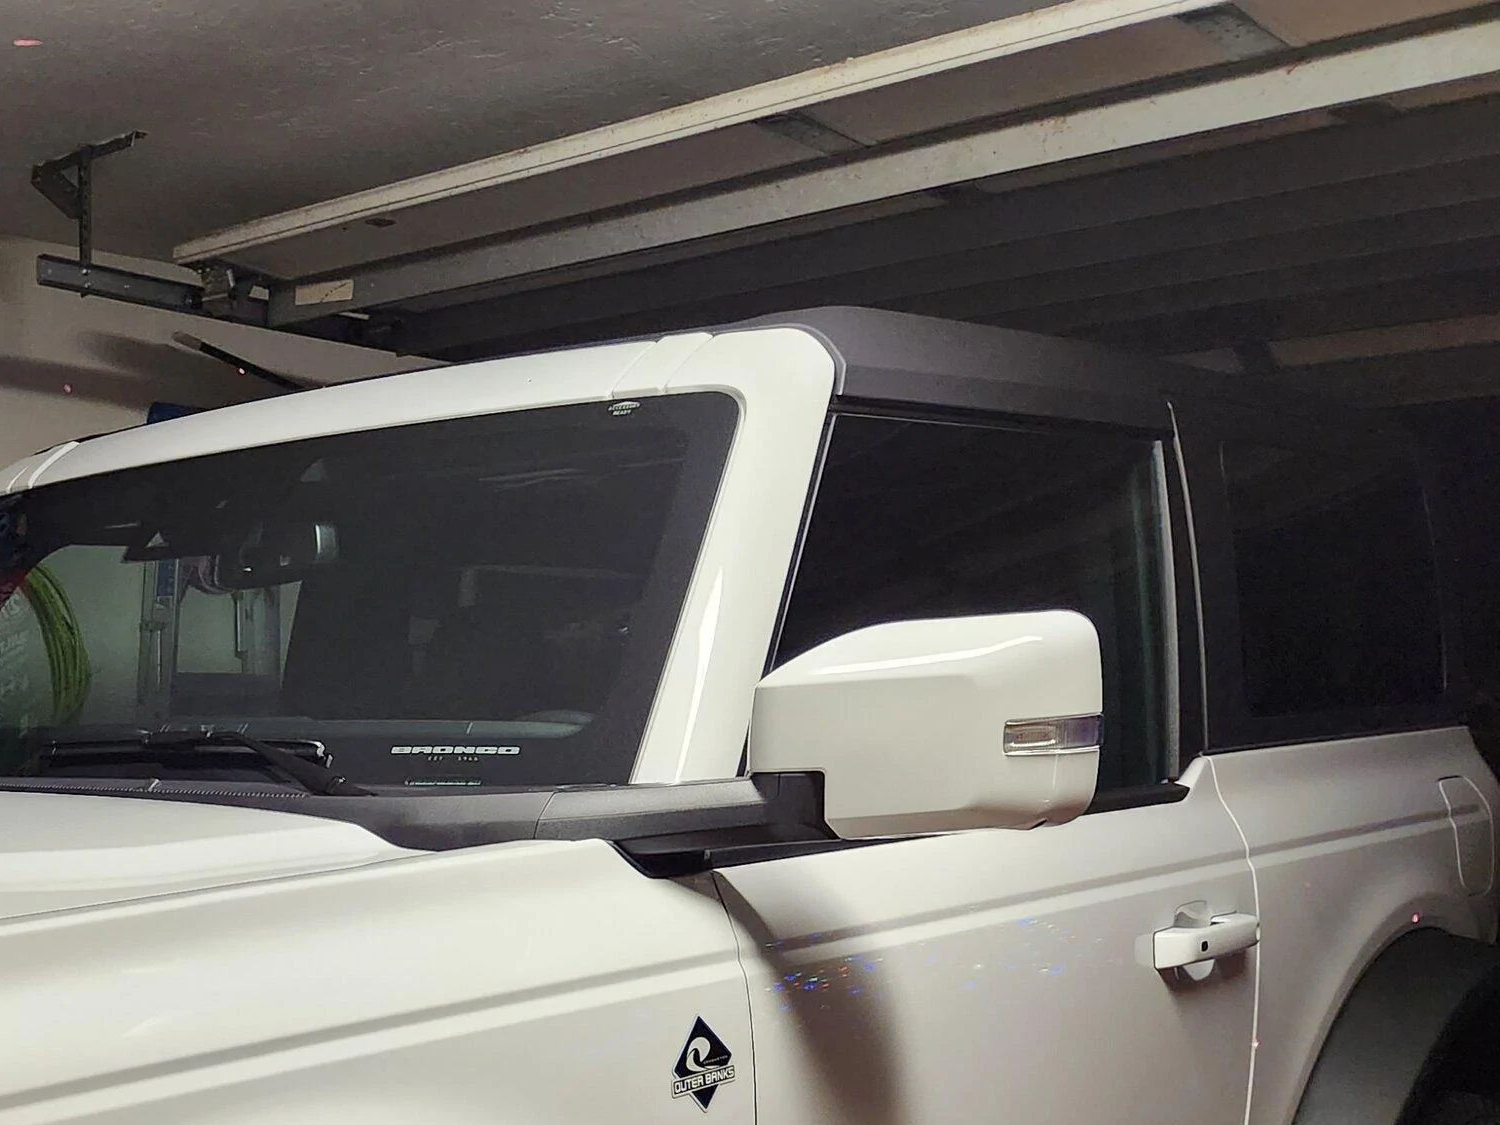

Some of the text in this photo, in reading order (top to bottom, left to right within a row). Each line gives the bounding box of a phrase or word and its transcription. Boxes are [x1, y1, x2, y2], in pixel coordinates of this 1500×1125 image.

[390, 746, 521, 755] BRONCO
[674, 1066, 735, 1093] OUTER BANKS
